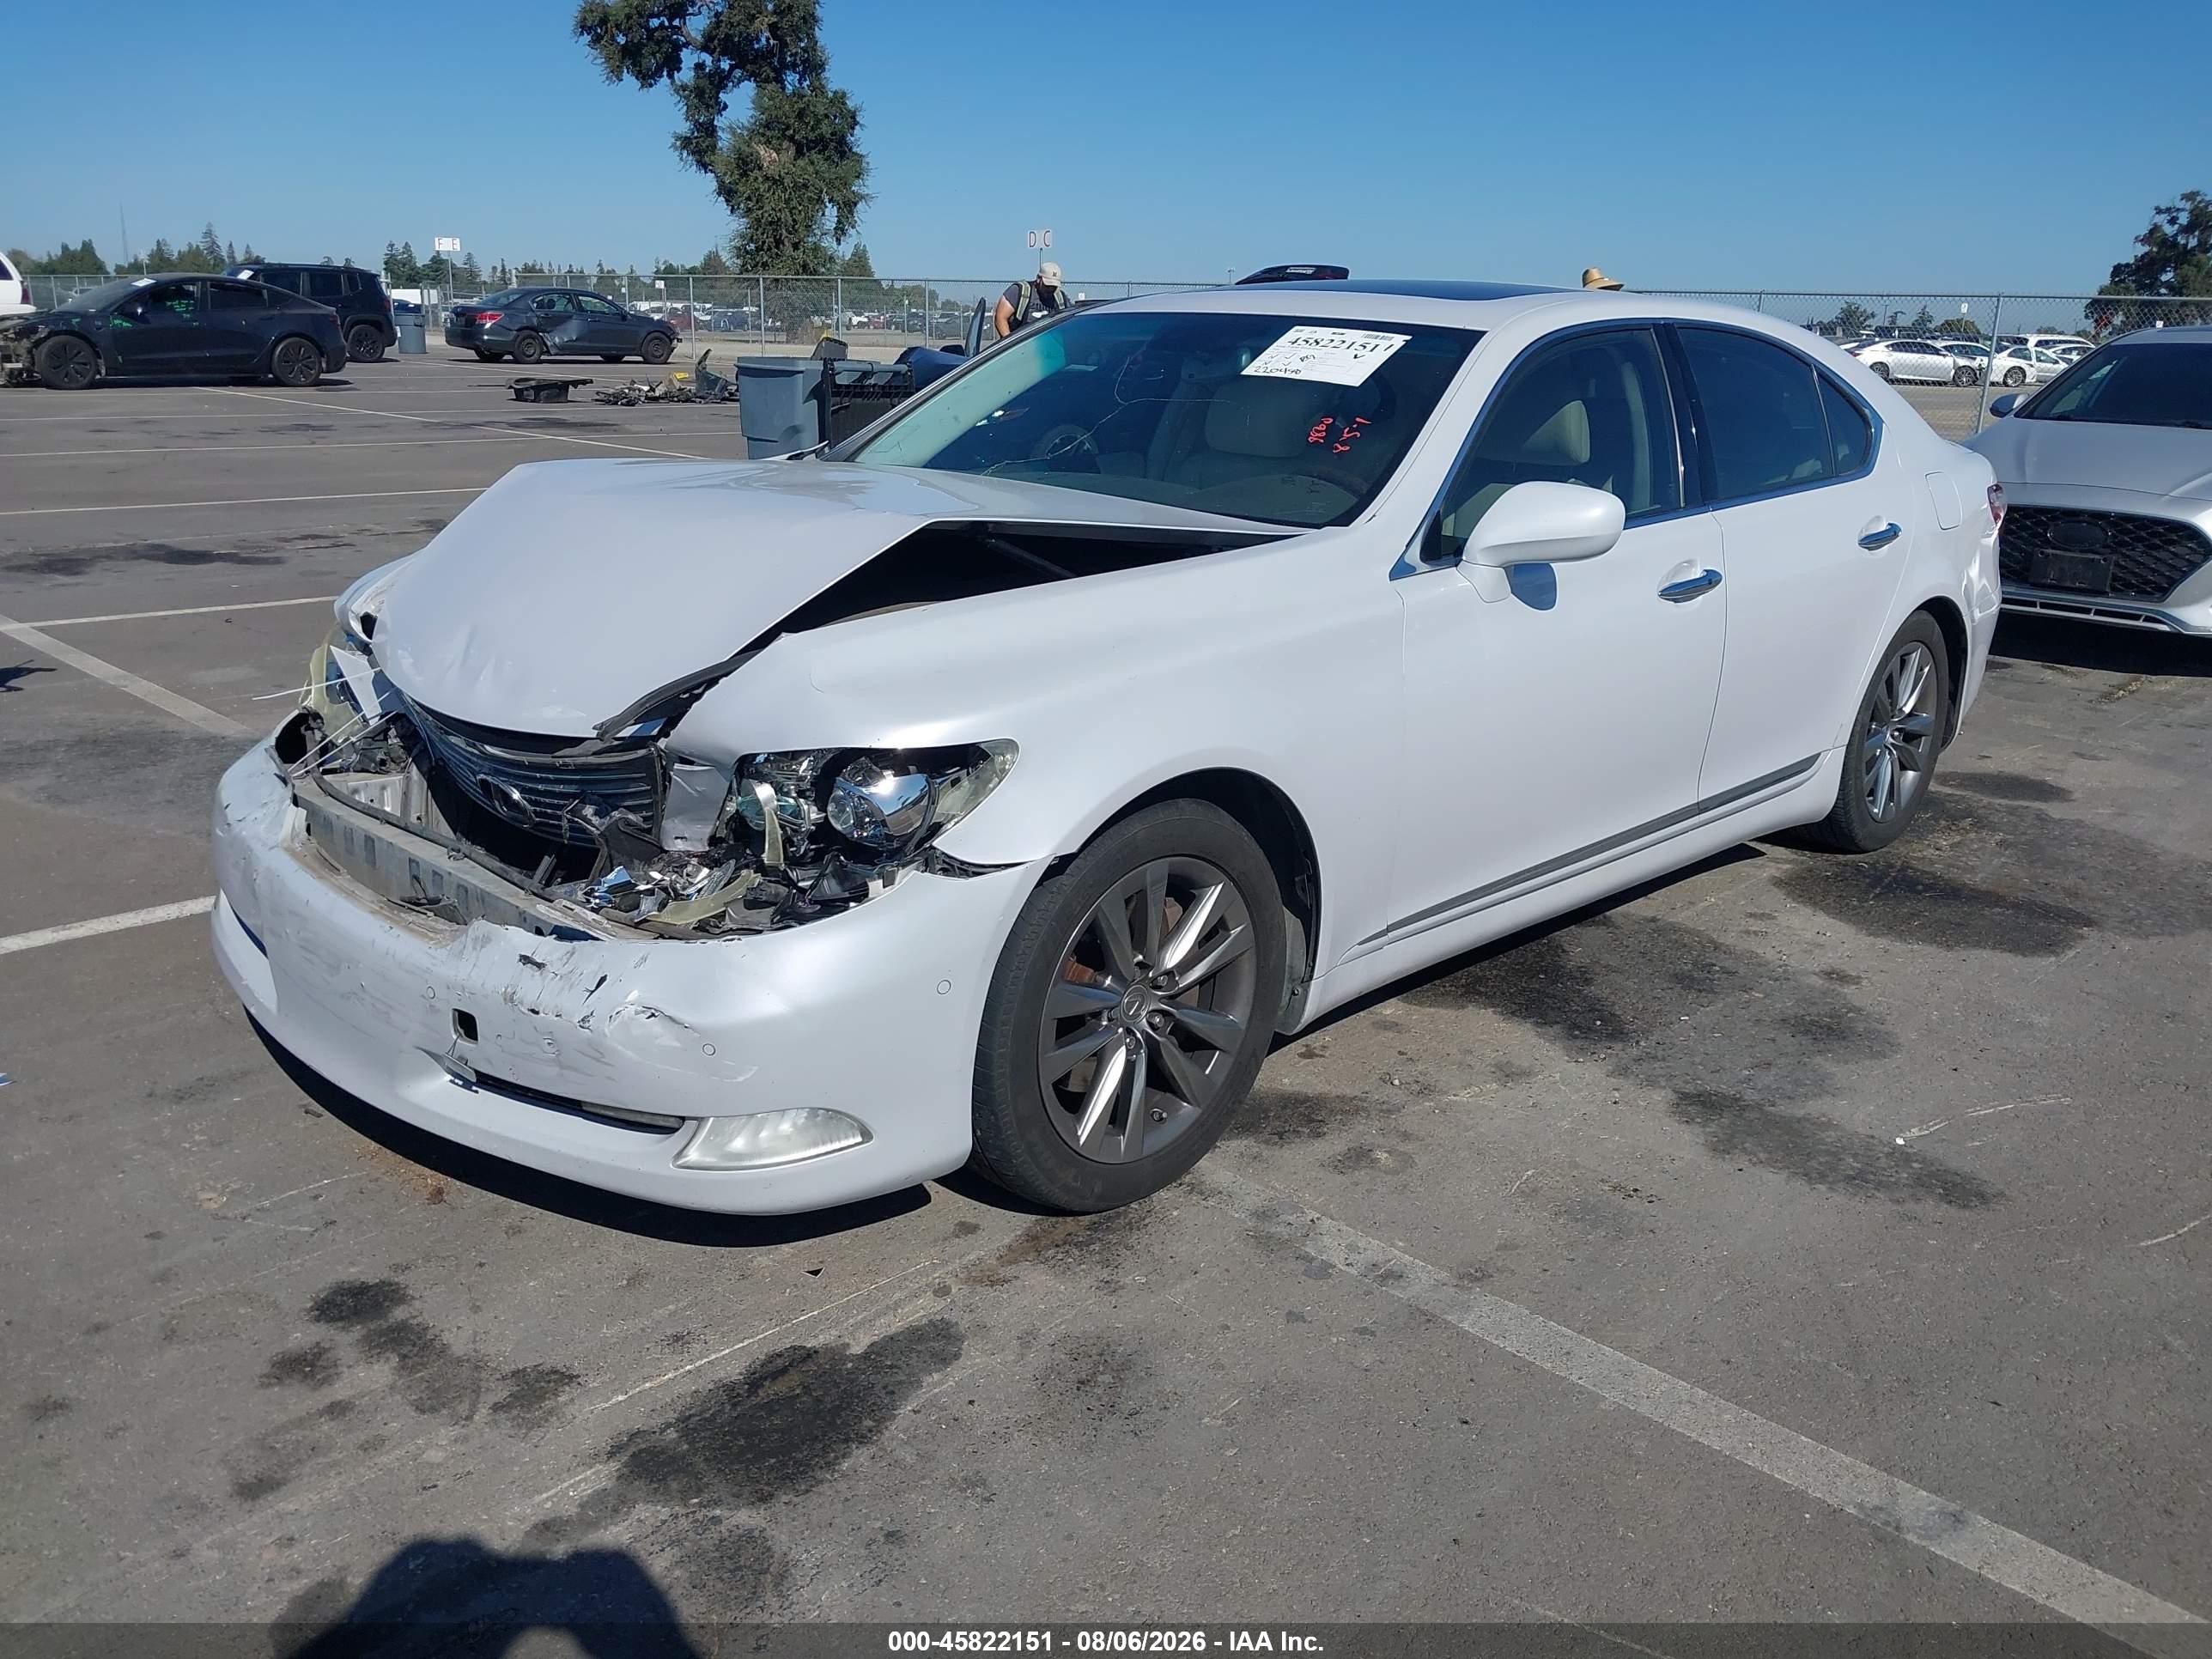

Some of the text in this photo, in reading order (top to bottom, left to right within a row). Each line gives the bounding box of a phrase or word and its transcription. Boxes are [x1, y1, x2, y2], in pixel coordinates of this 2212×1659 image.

[437, 238, 459, 251] F E
[1029, 230, 1051, 248] D C
[1288, 337, 1381, 352] 45822151
